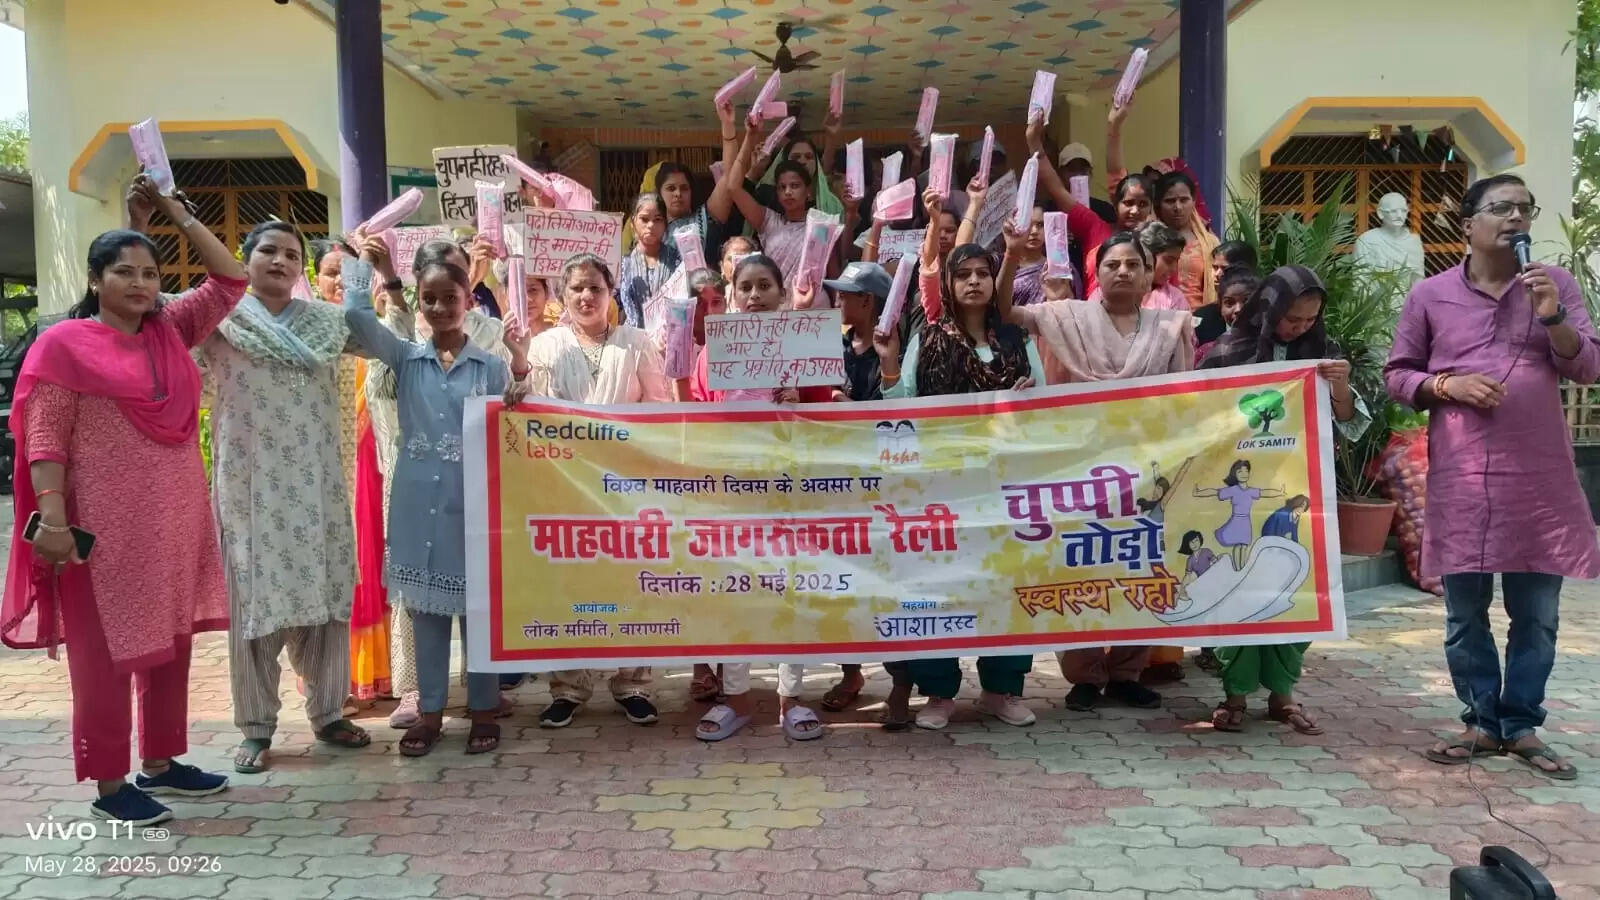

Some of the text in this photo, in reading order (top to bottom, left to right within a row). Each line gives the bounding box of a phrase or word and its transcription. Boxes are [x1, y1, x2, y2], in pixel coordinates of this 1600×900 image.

[726, 341, 759, 357] भार
[708, 360, 742, 379] यह
[527, 419, 630, 441] Redcliffe
[527, 441, 573, 459] labs
[1236, 437, 1297, 449] LOK SAMITI
[602, 472, 882, 496] विश्व माहवारी दिवस के अवसर पर
[1001, 464, 1140, 542] चुप्पी
[529, 508, 673, 559] माहवारी
[873, 503, 959, 553] रैली
[1061, 517, 1164, 570] तोड़ो
[638, 570, 703, 596] दिनांक
[758, 568, 787, 597] मई
[794, 573, 853, 592] 2025
[1013, 562, 1181, 618] स्वस्थ रहो
[572, 600, 618, 614] आयोजक
[900, 598, 937, 612] सहयोग
[523, 618, 682, 639] लोक समिति, वाराणसी
[879, 616, 937, 638] आशा
